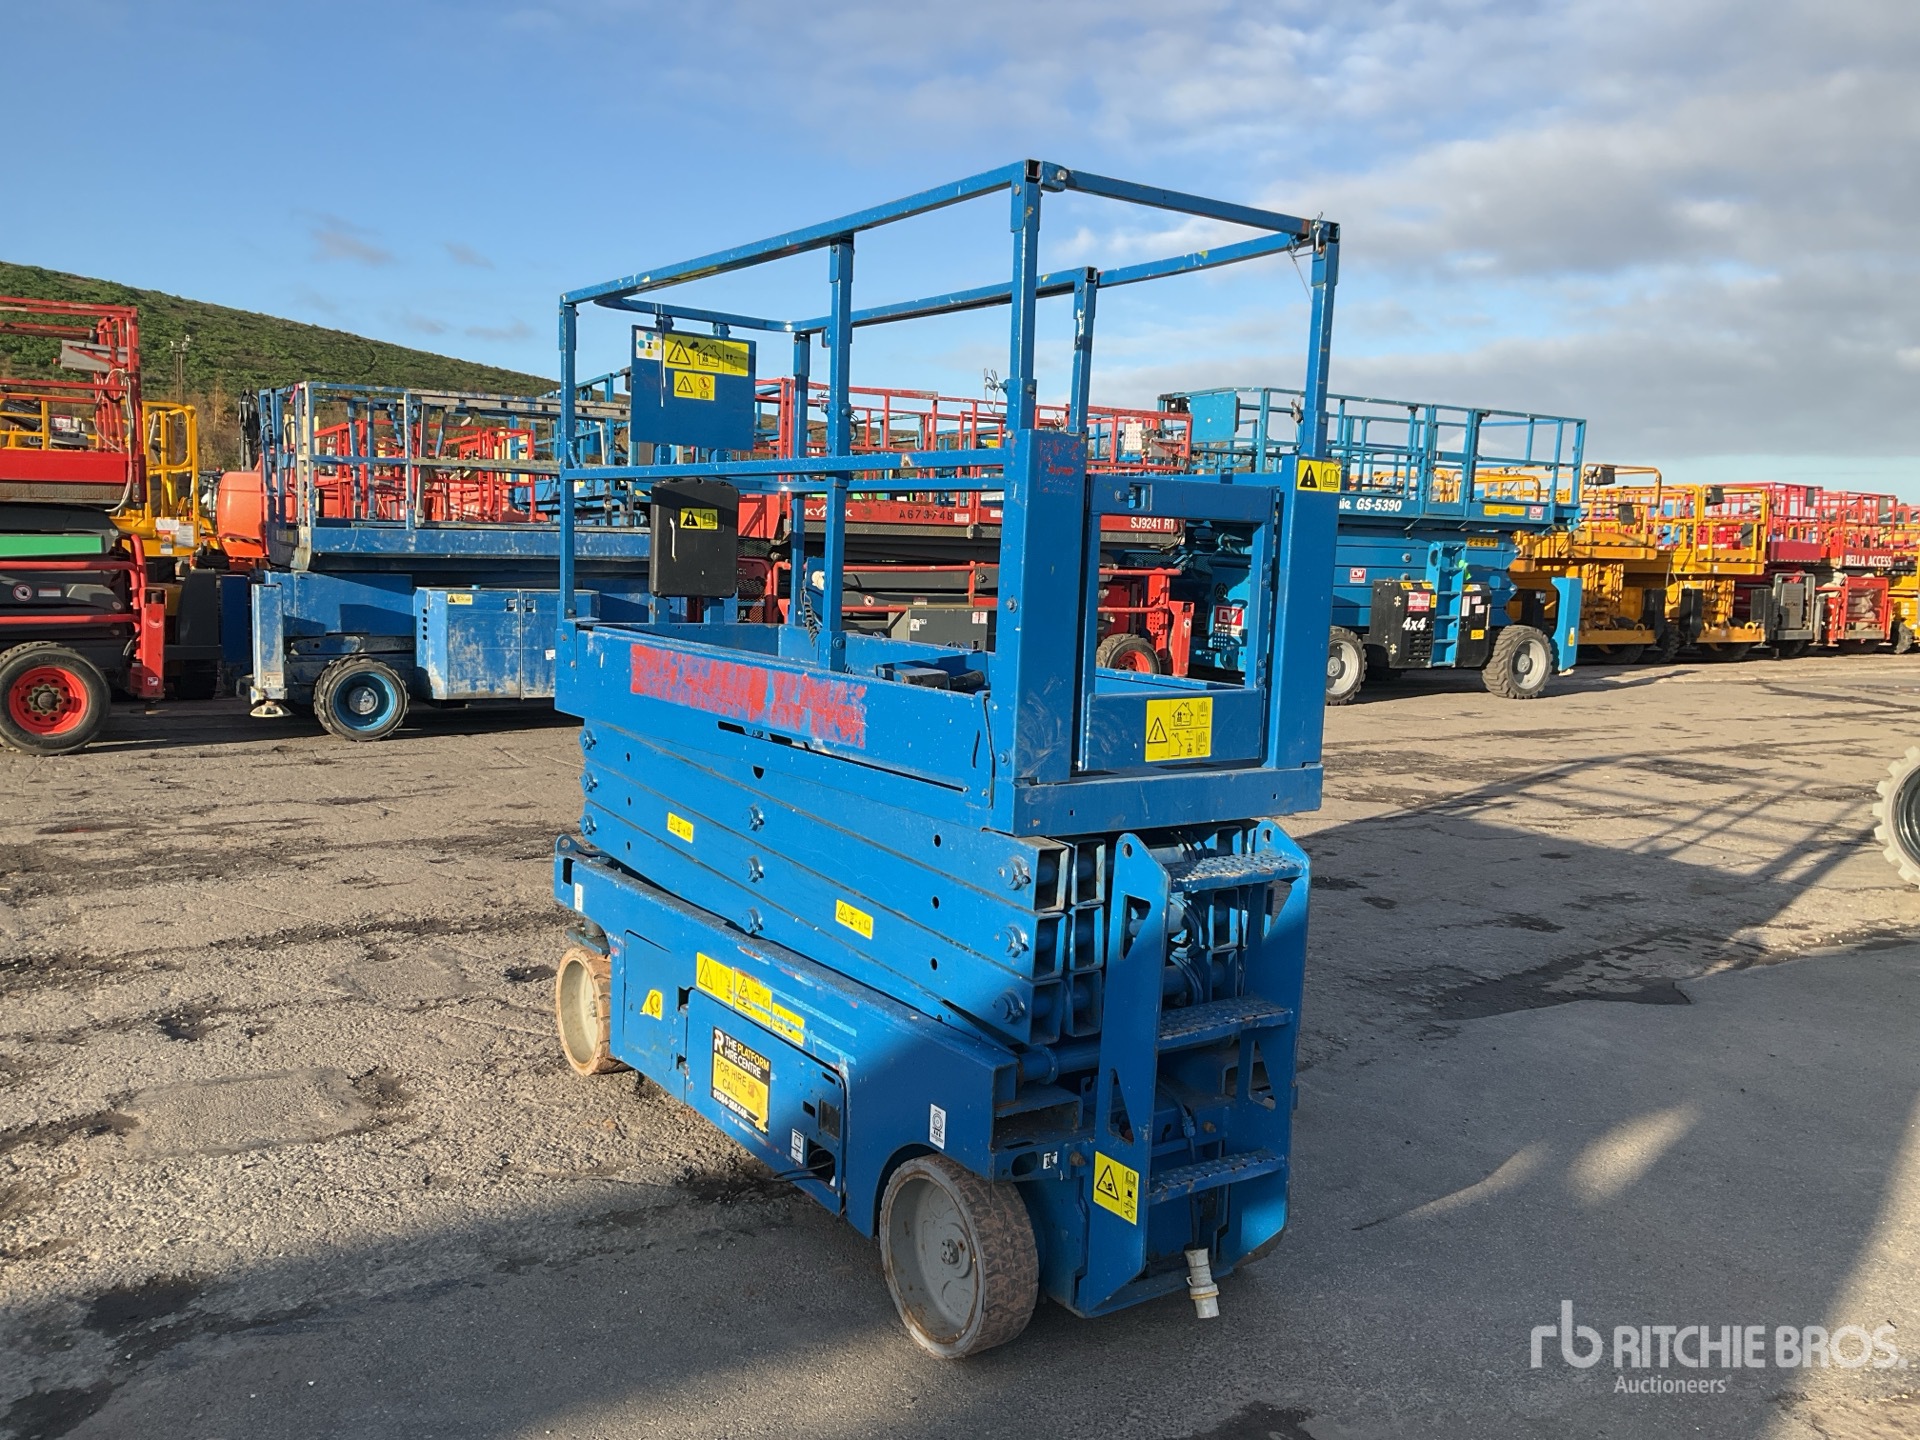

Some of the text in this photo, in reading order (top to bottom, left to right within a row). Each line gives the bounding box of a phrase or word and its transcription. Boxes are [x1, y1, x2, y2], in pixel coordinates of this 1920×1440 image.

[1356, 498, 1402, 512] GS-5390
[1130, 517, 1174, 530] SJ9241 RT
[1845, 555, 1892, 567] BELLA ACCESS
[1402, 617, 1427, 631] 4x4
[724, 1046, 761, 1078] HIRE CENTRE
[725, 1035, 769, 1072] THE PLATFORM
[716, 1058, 747, 1088] FOR HIRE
[722, 1078, 740, 1098] CALL
